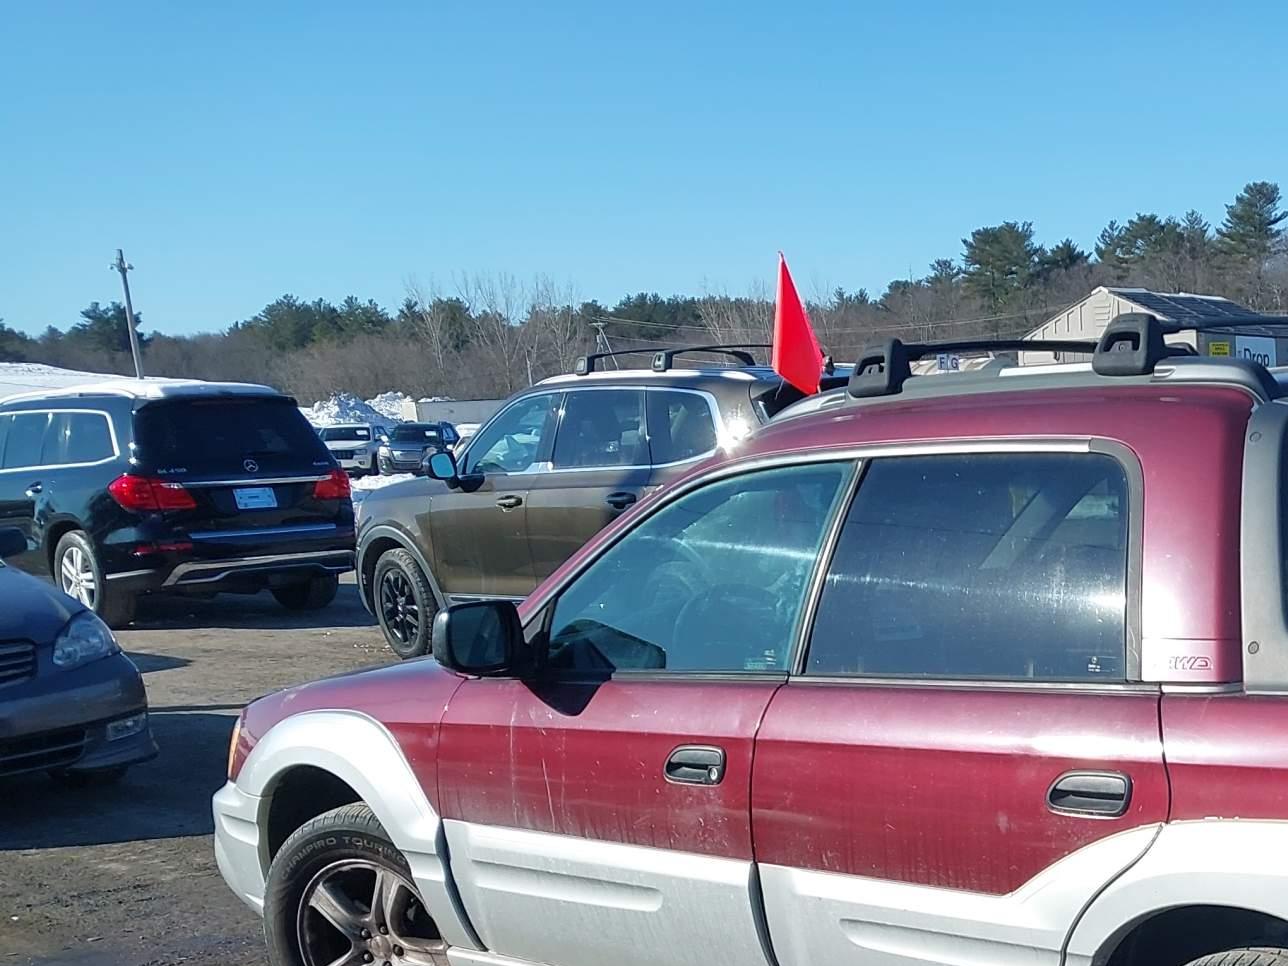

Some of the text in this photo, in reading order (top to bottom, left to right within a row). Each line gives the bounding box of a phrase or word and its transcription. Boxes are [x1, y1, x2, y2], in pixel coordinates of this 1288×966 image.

[939, 356, 945, 369] F
[951, 357, 959, 369] G
[1243, 347, 1270, 367] Drop
[1166, 655, 1214, 671] WD
